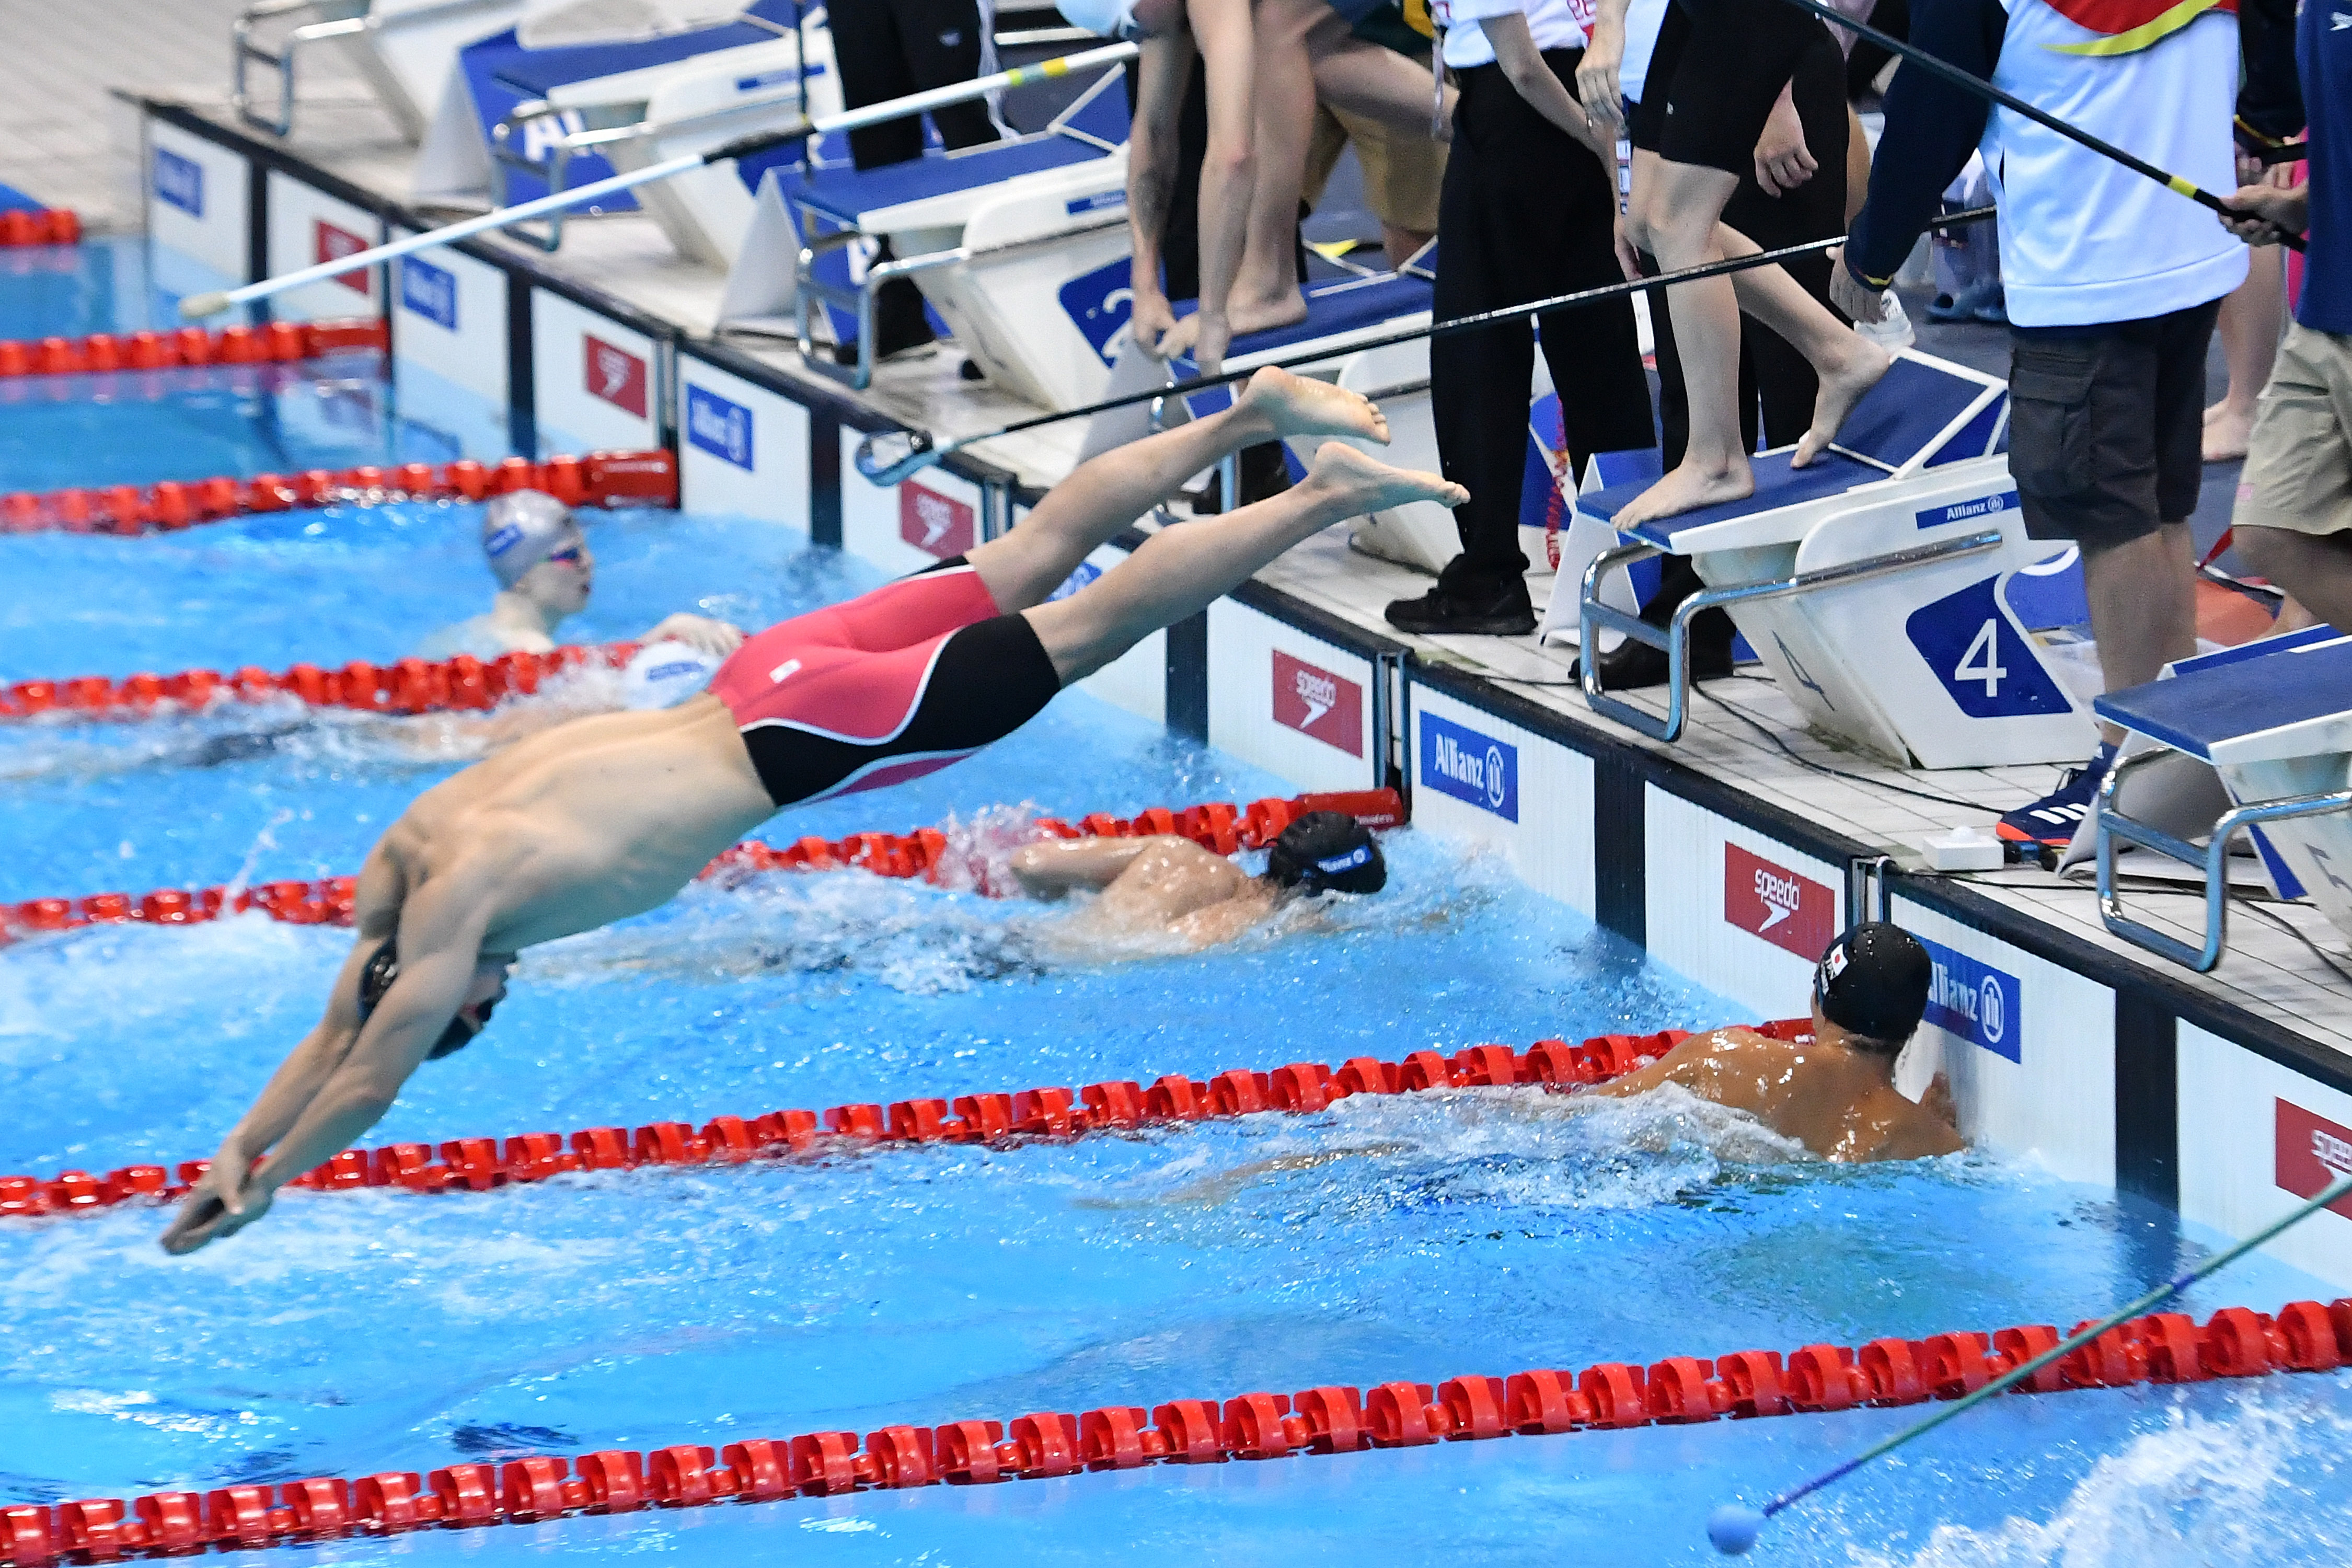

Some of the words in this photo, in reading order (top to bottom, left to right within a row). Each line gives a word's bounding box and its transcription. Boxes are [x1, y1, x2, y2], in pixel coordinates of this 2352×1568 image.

[1947, 502, 1986, 521] Allianz
[1954, 618, 2007, 698] 4
[1434, 733, 1485, 790] Allianz
[1754, 868, 1801, 911] speedo
